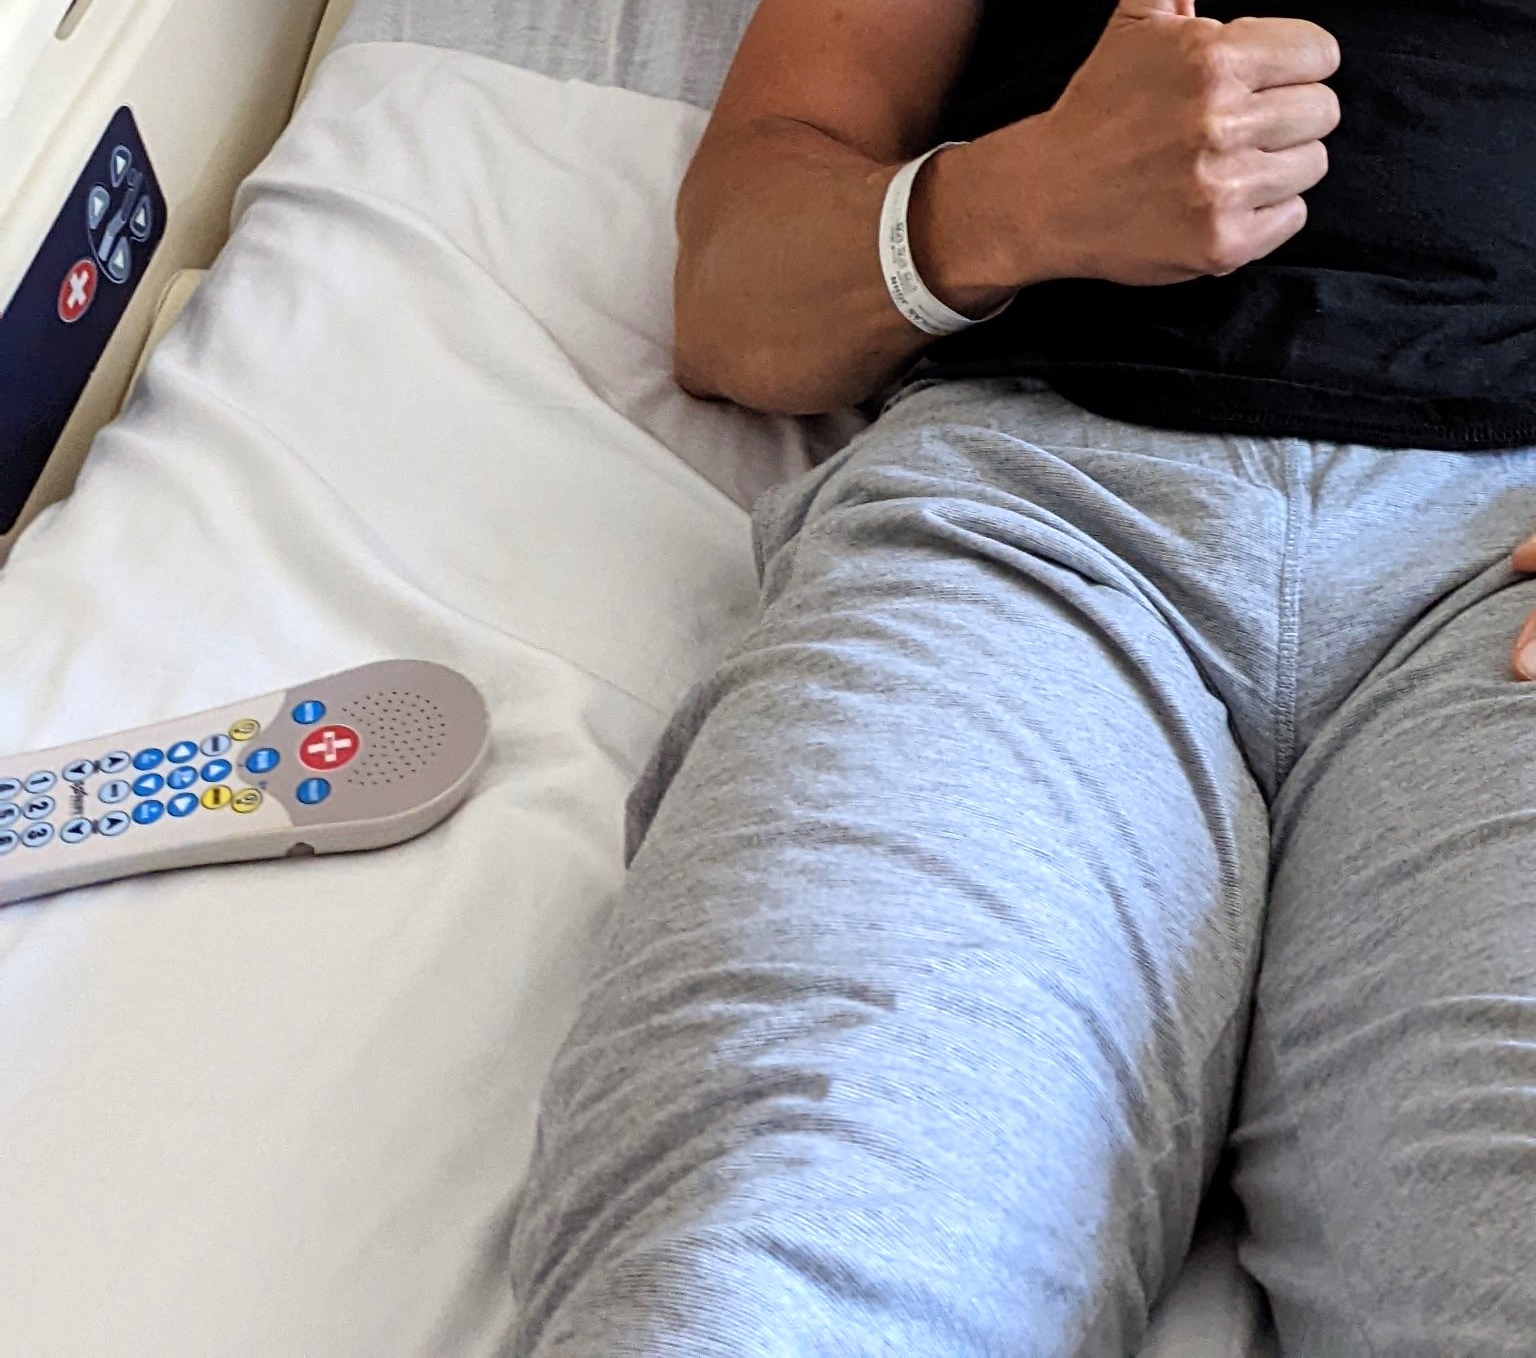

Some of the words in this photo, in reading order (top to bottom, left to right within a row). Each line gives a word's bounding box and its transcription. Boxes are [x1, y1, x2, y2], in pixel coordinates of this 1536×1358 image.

[30, 776, 50, 785] 1
[29, 801, 49, 813] 2
[26, 828, 48, 840] 3
